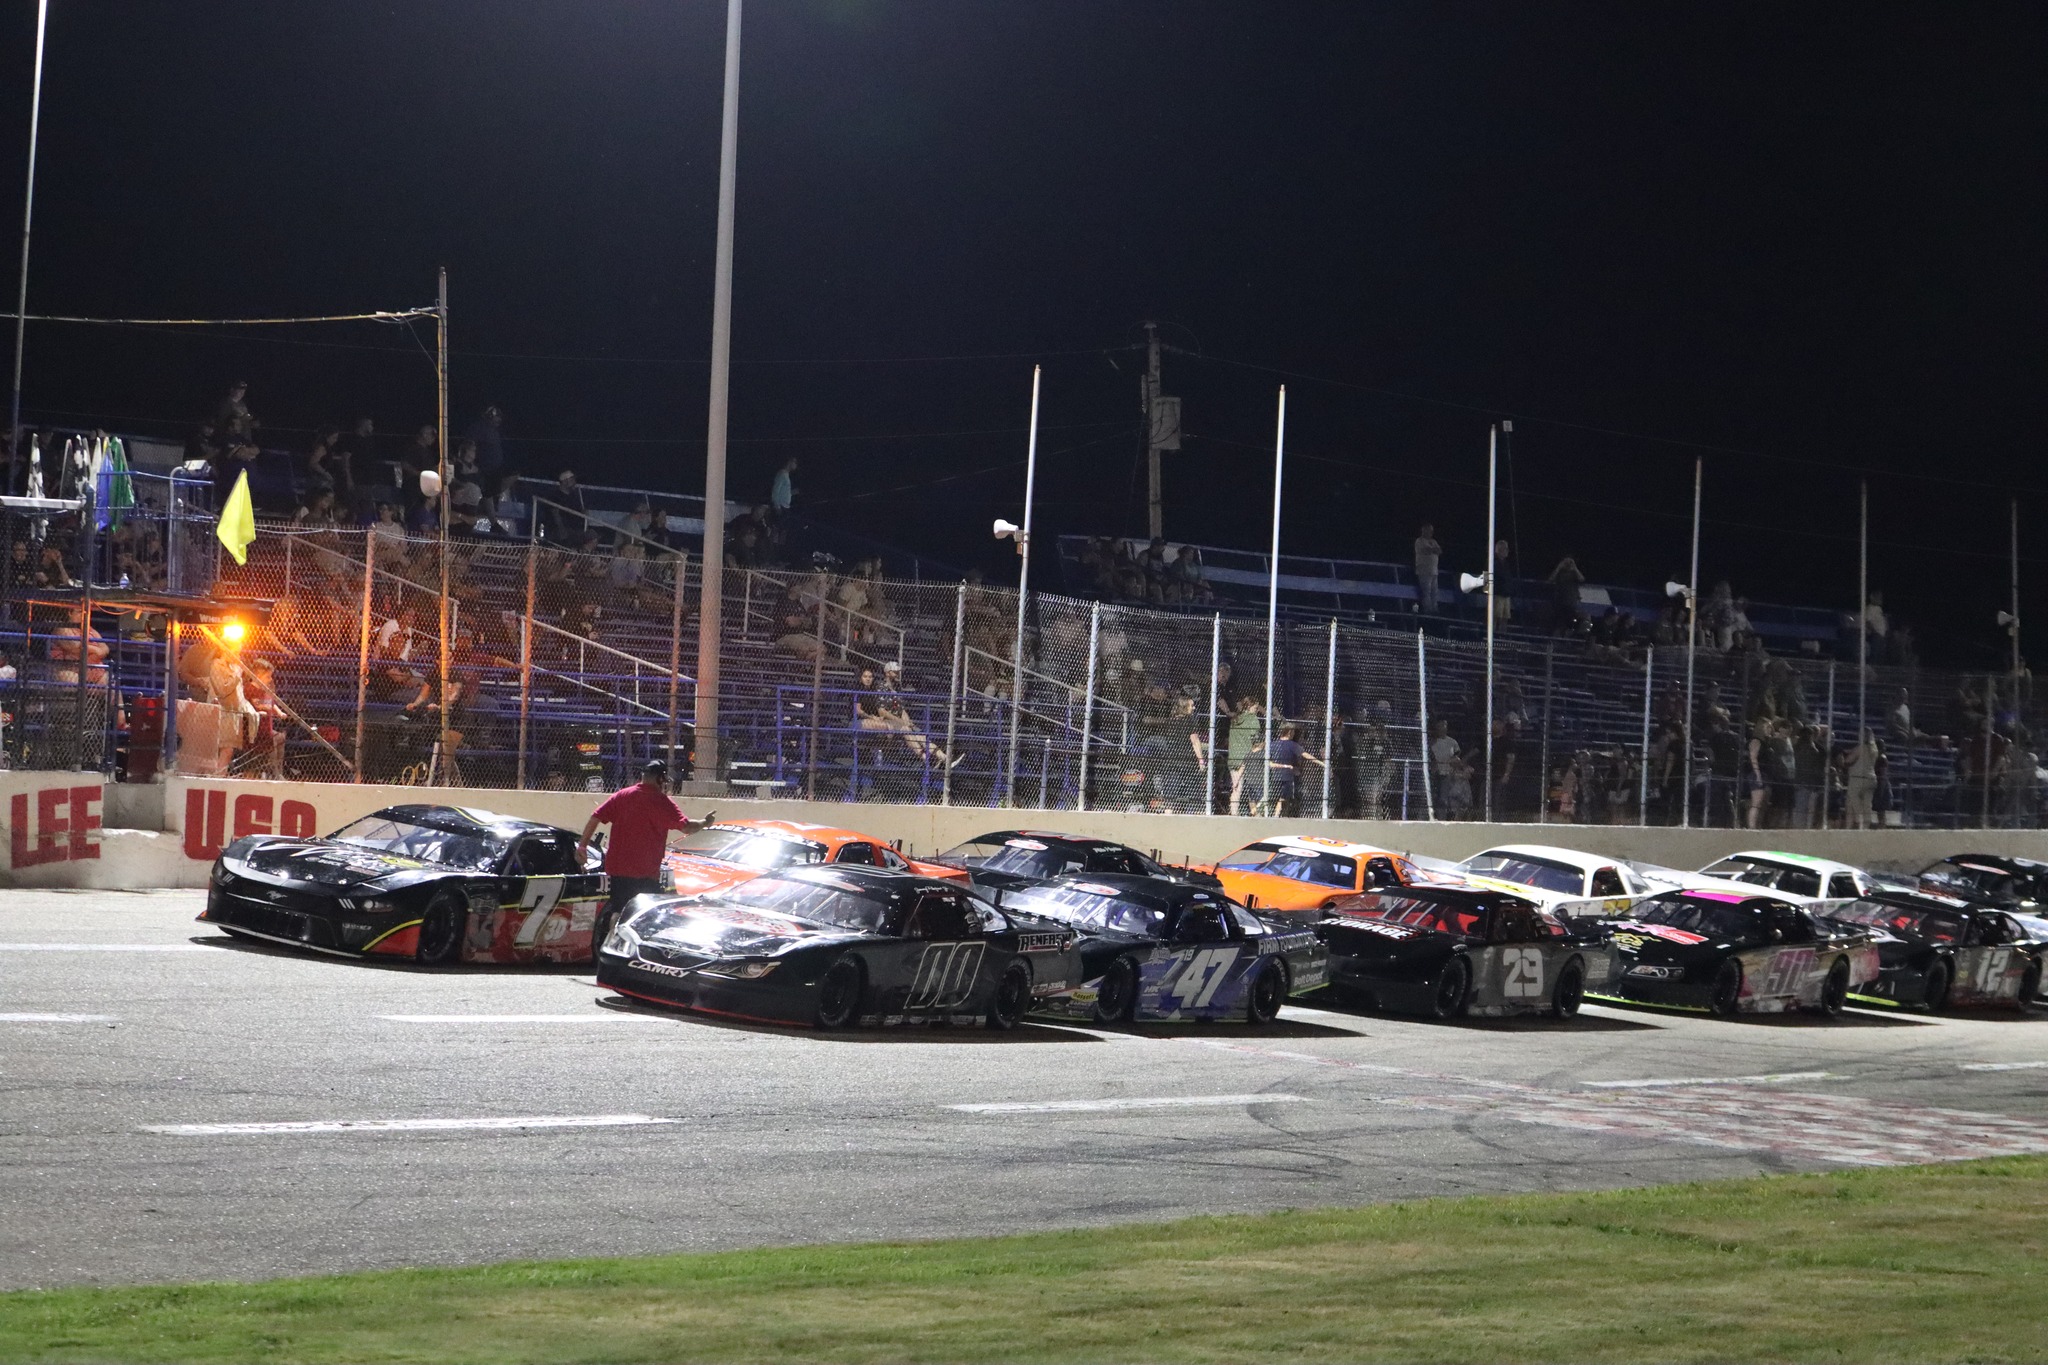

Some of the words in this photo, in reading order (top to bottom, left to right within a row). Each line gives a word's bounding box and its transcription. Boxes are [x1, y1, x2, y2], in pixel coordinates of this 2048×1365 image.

[11, 786, 102, 869] LEE
[513, 875, 567, 950] 7
[628, 960, 690, 978] CAMRY
[903, 941, 986, 1009] 00
[1172, 947, 1240, 1009] 47
[1503, 948, 1544, 997] 29
[1976, 950, 2010, 992] 12
